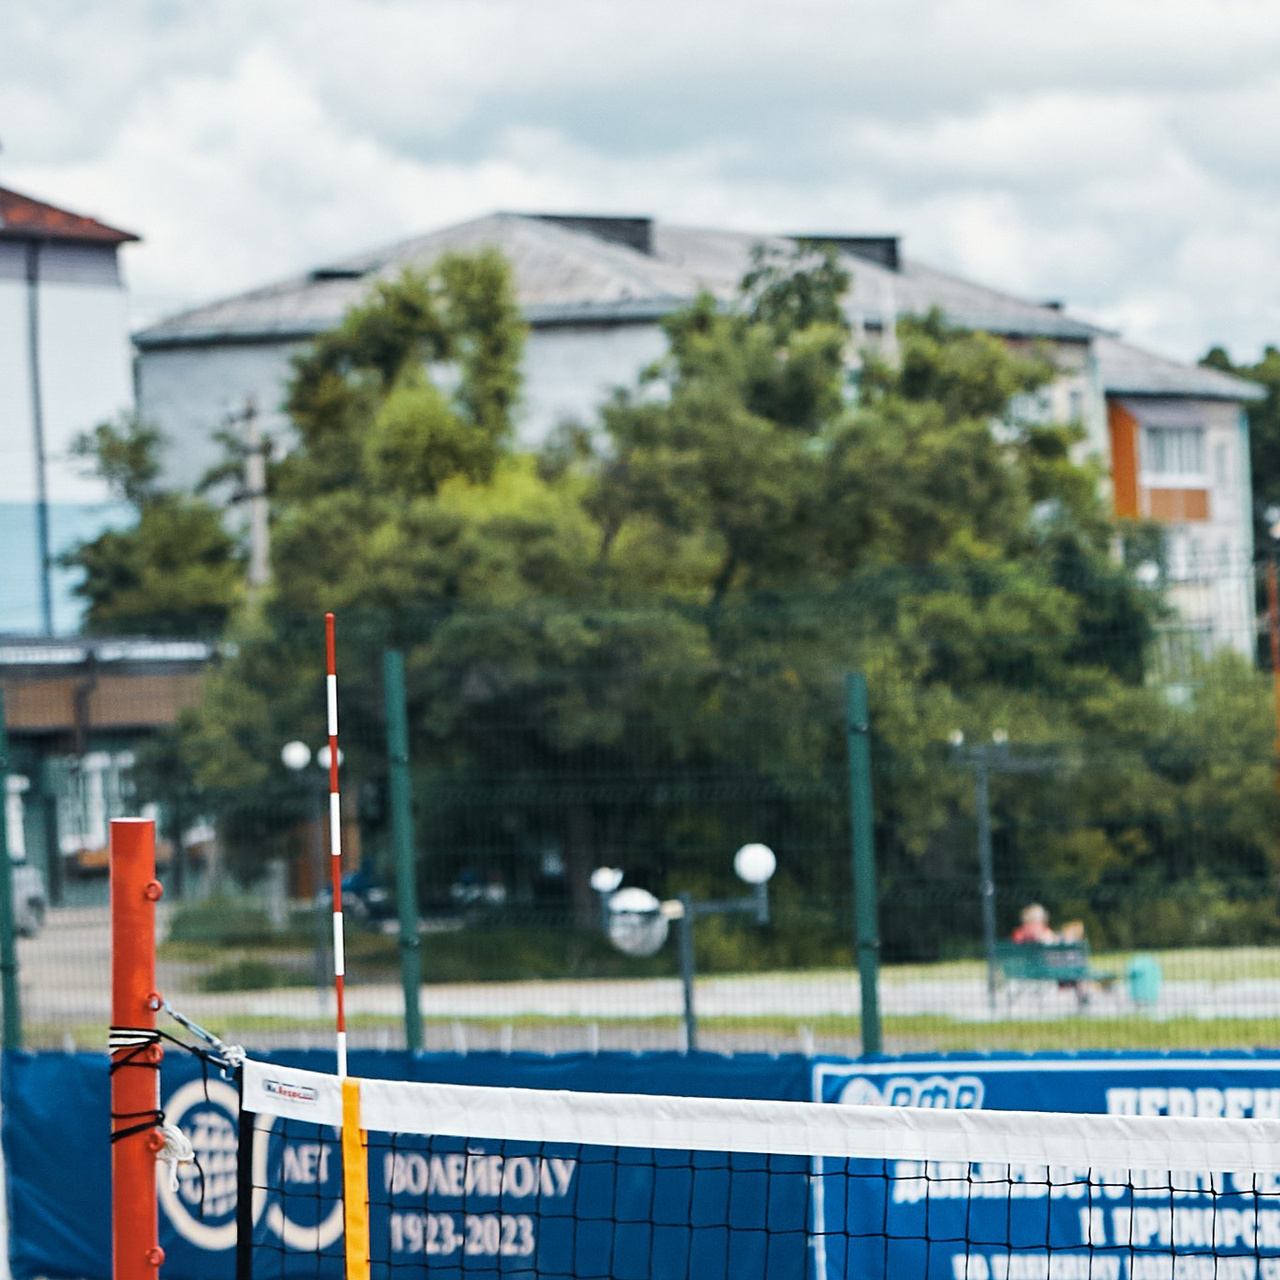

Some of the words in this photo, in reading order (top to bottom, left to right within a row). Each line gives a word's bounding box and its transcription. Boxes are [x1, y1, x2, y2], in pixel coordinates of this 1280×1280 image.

[279, 1145, 332, 1184] ЛЕТ
[383, 1148, 576, 1198] ВОЛЕЙБОЛУ
[390, 1212, 536, 1257] 1923-2023
